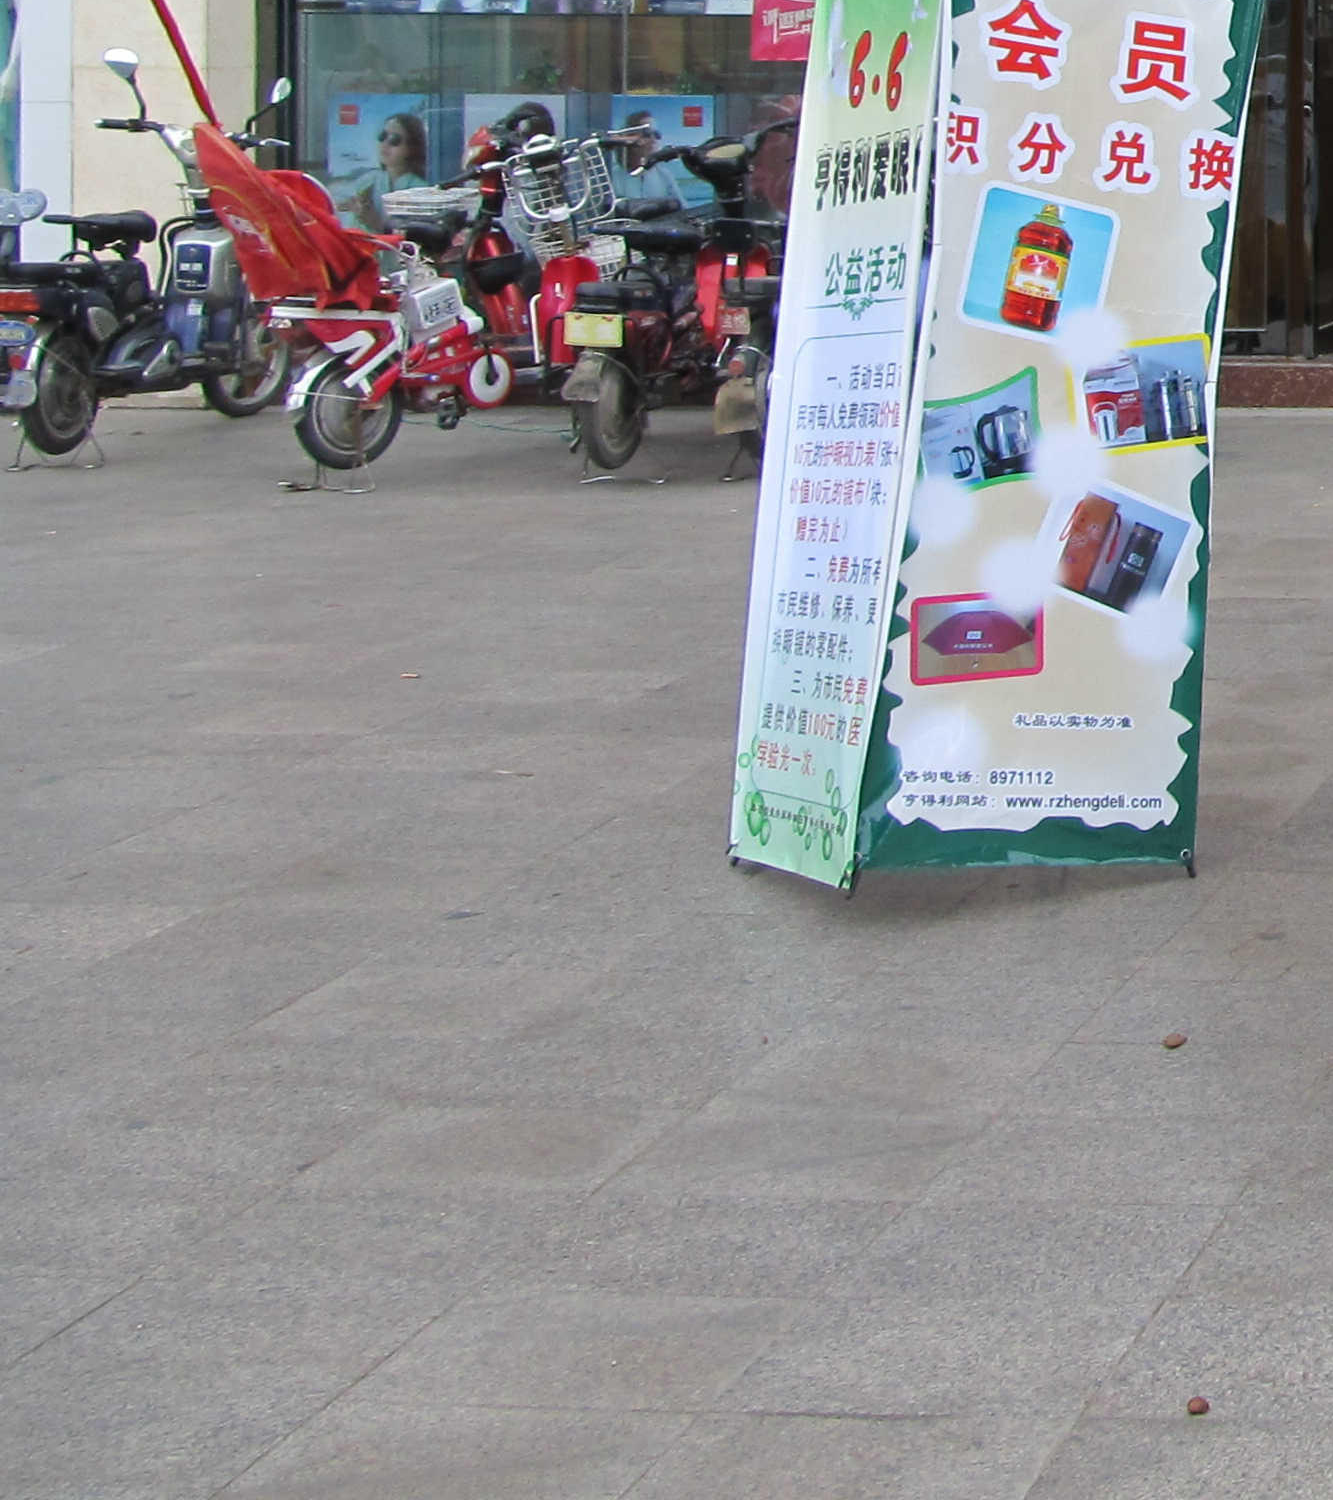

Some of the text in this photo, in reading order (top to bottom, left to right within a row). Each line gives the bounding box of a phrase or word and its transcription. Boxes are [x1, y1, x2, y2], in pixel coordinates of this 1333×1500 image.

[824, 242, 907, 297] 公益活动
[1013, 712, 1134, 730] 礼品以实物为准
[989, 769, 1054, 786] 8971112
[1005, 792, 1163, 811] www.rzhengdeli.com
